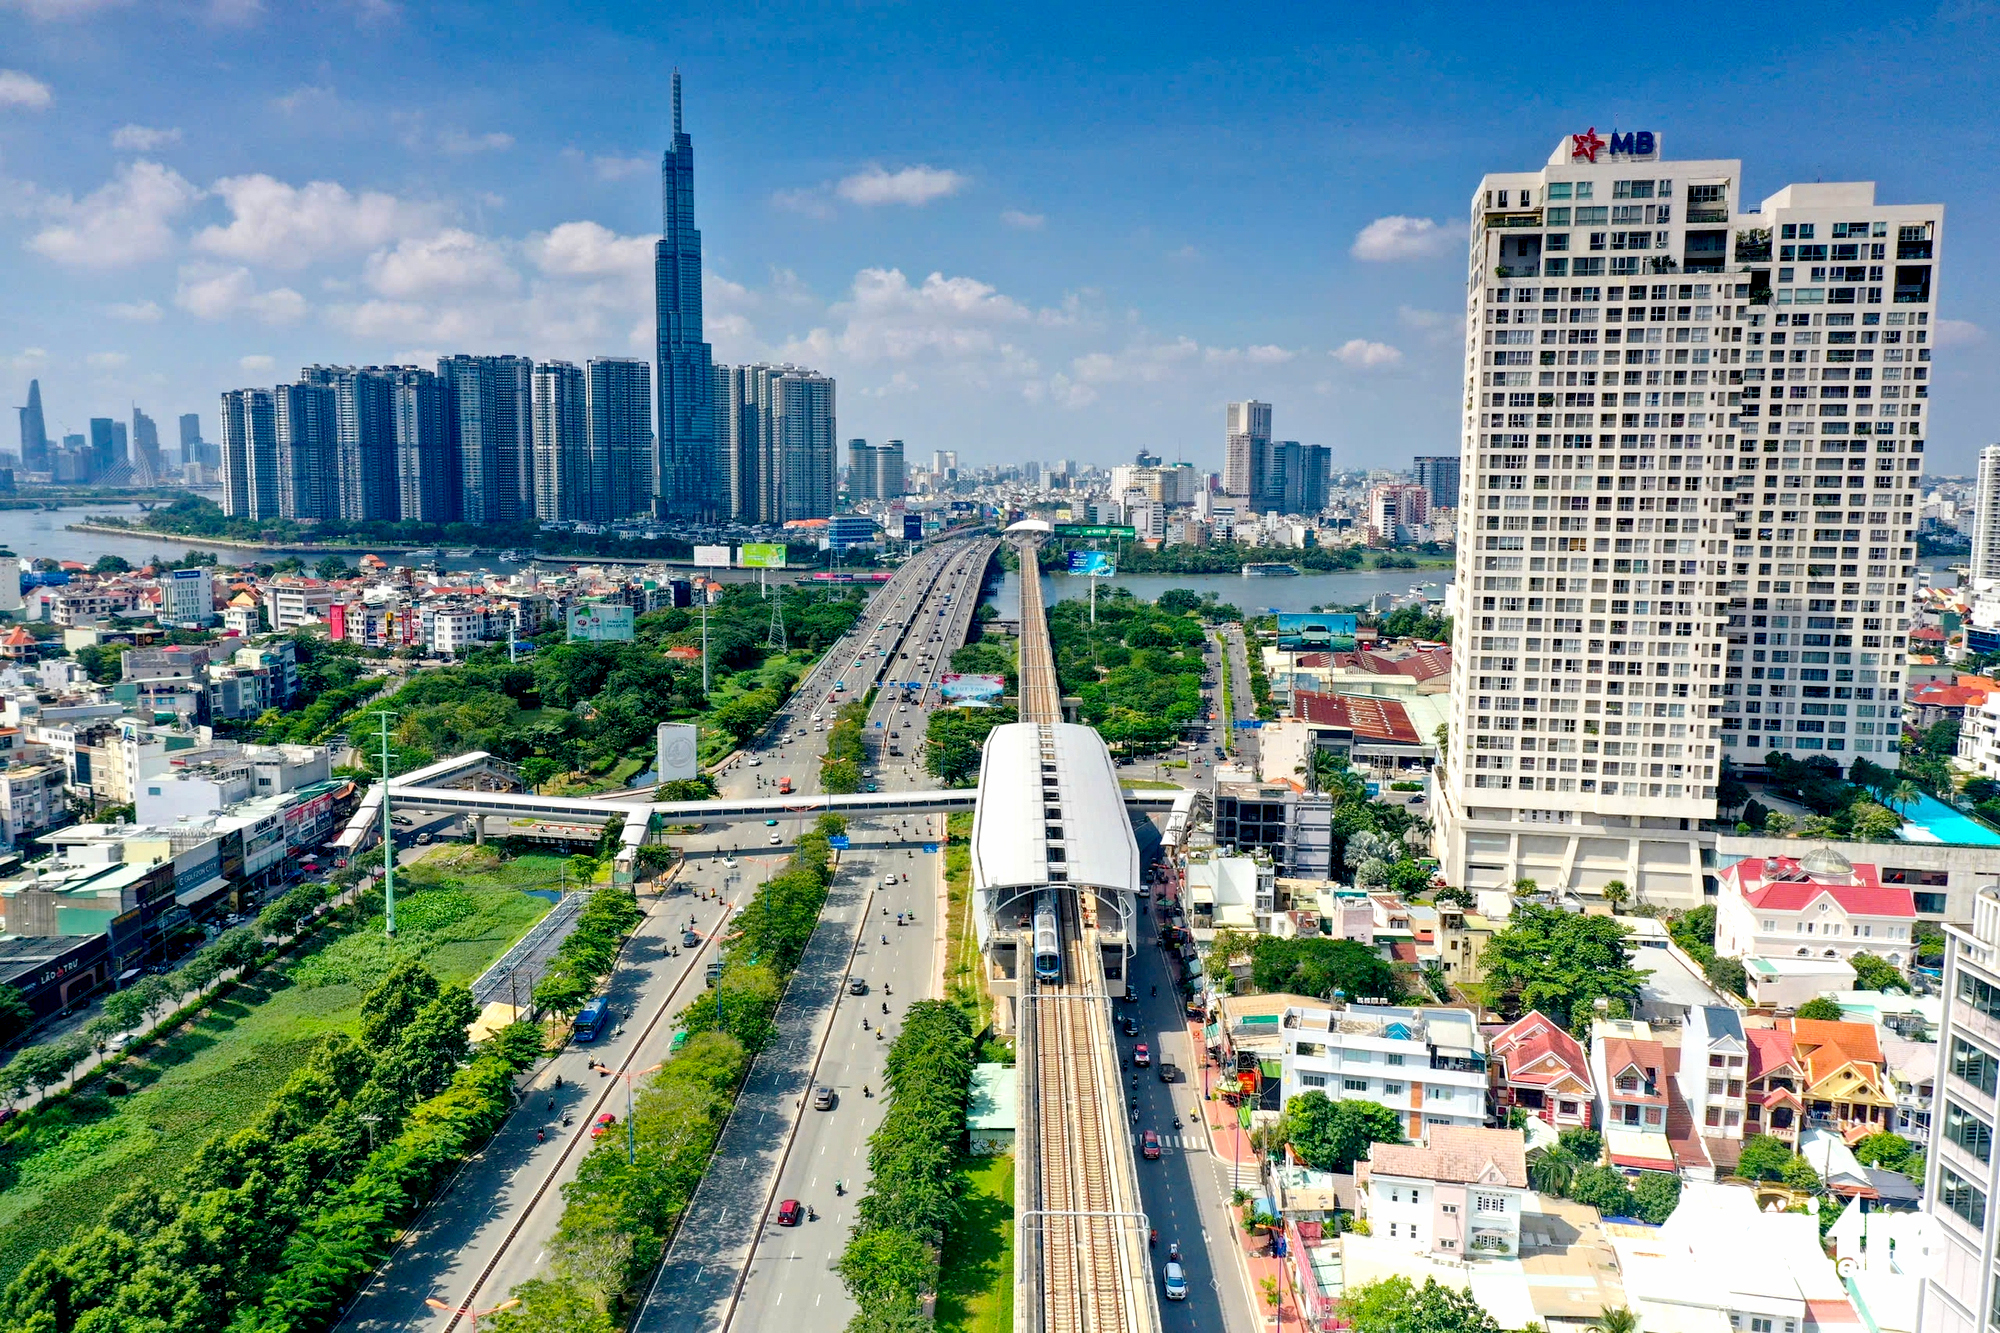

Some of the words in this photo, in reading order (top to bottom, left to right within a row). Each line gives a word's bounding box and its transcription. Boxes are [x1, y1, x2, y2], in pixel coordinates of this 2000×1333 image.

[1610, 131, 1654, 155] MB
[253, 819, 270, 833] JANG
[270, 814, 277, 825] IN
